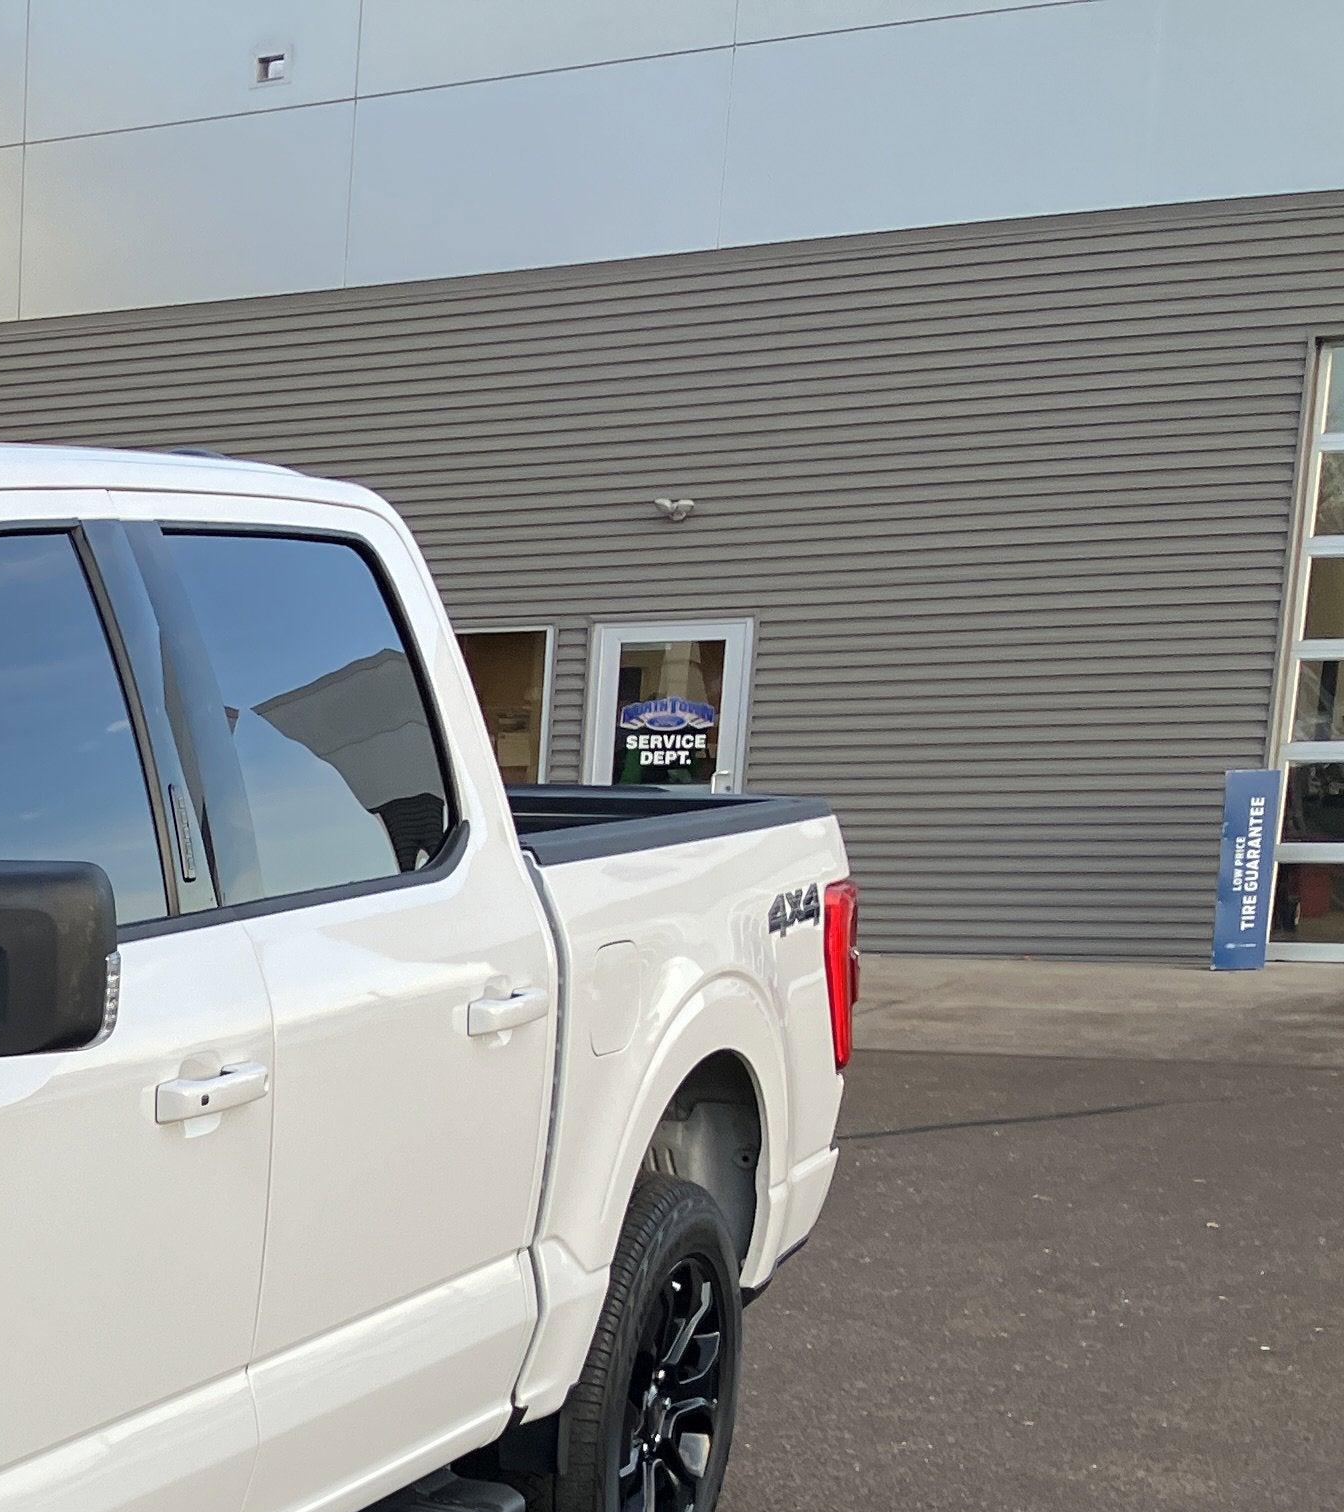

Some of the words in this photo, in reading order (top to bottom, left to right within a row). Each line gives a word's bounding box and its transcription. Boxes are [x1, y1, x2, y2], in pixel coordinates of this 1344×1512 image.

[625, 734, 707, 750] SERVICE
[639, 750, 692, 766] DEPT.
[1235, 835, 1247, 864] PRICE
[1243, 796, 1266, 893] GUARANTEE
[1232, 864, 1245, 892] LOW
[1240, 894, 1258, 932] TIRE
